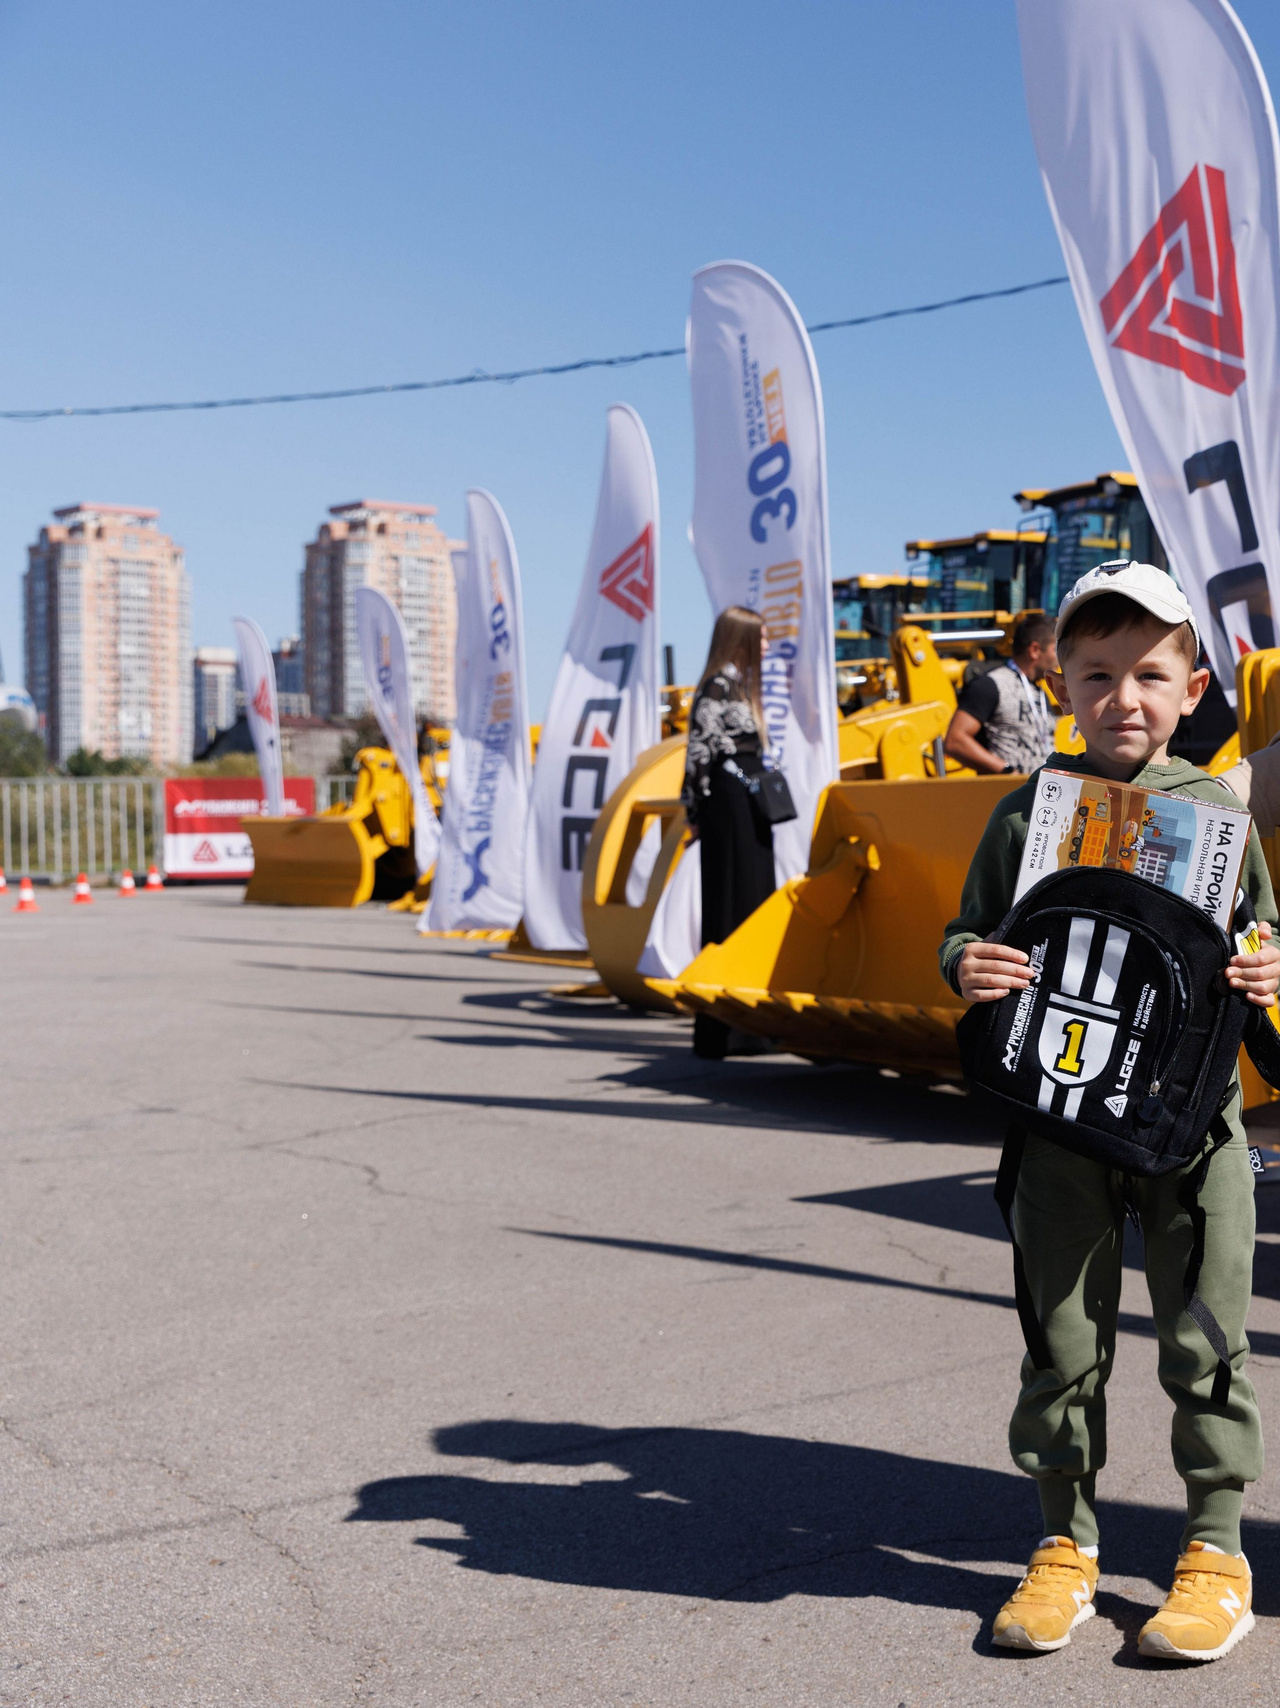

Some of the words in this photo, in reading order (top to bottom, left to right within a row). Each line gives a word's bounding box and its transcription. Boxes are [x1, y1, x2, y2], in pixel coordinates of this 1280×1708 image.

[562, 643, 635, 871] LGCE
[1046, 783, 1057, 799] 5+
[1196, 819, 1214, 882] настольная
[1217, 821, 1235, 846] НА
[1189, 883, 1202, 904] игр
[1202, 853, 1228, 921] СТРОЙК
[1133, 983, 1150, 1027] НАДЕЖНОСТЬ
[1143, 989, 1157, 1024] ДЕЙСТВИИ
[1055, 1020, 1087, 1076] 1
[1115, 1039, 1141, 1091] LGCE
